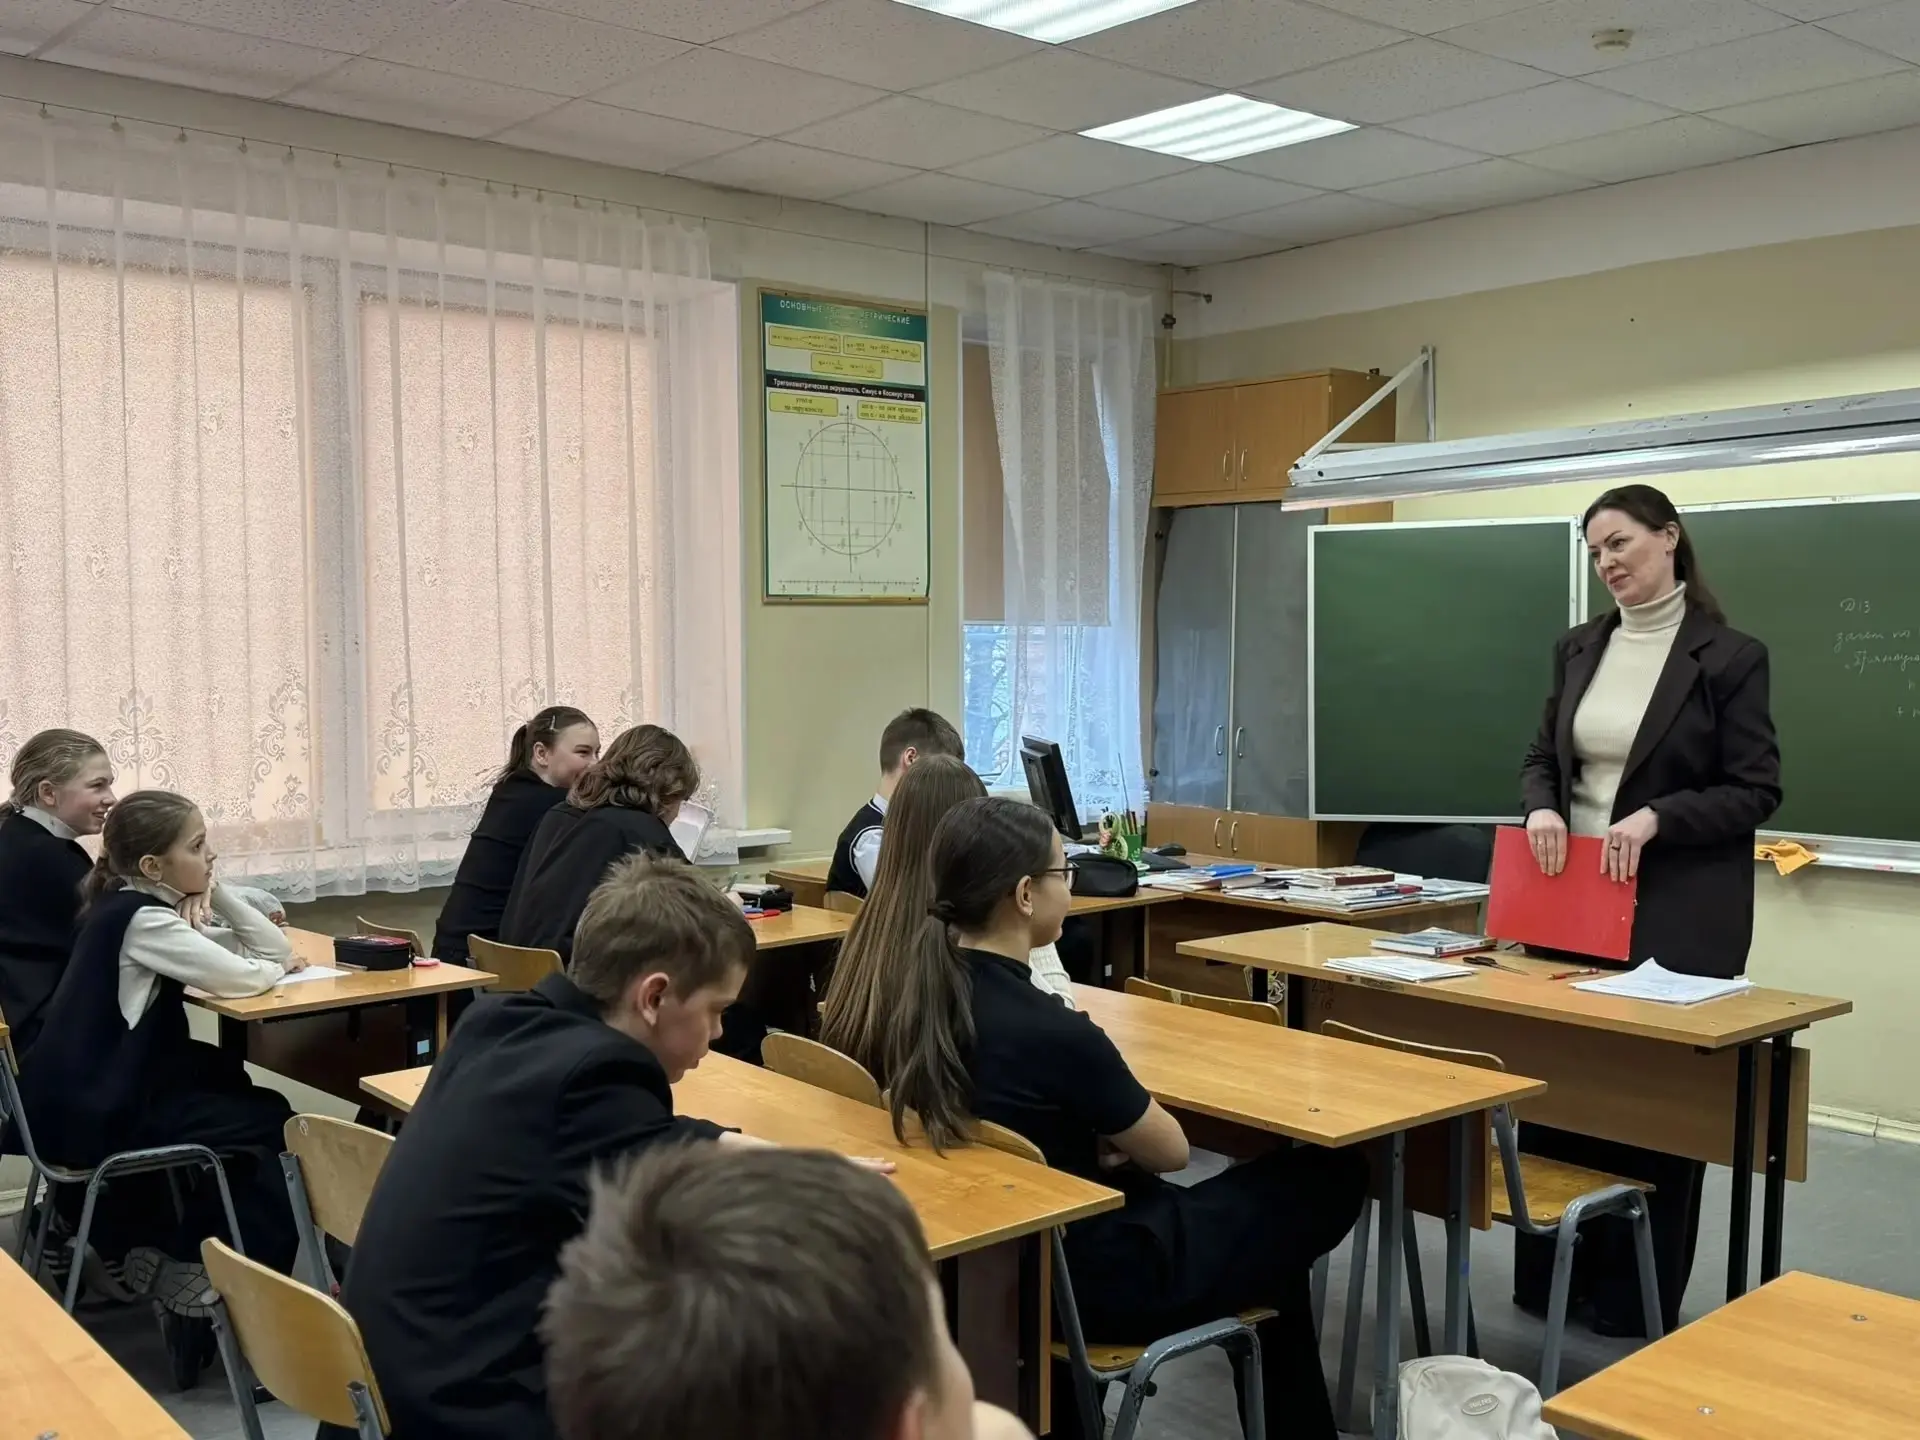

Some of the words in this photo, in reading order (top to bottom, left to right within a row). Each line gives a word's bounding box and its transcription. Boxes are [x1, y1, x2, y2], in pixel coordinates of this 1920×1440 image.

[780, 300, 822, 313] ОСНОВНЫЕ
[861, 387, 877, 396] Синус
[882, 389, 903, 399] Косинус
